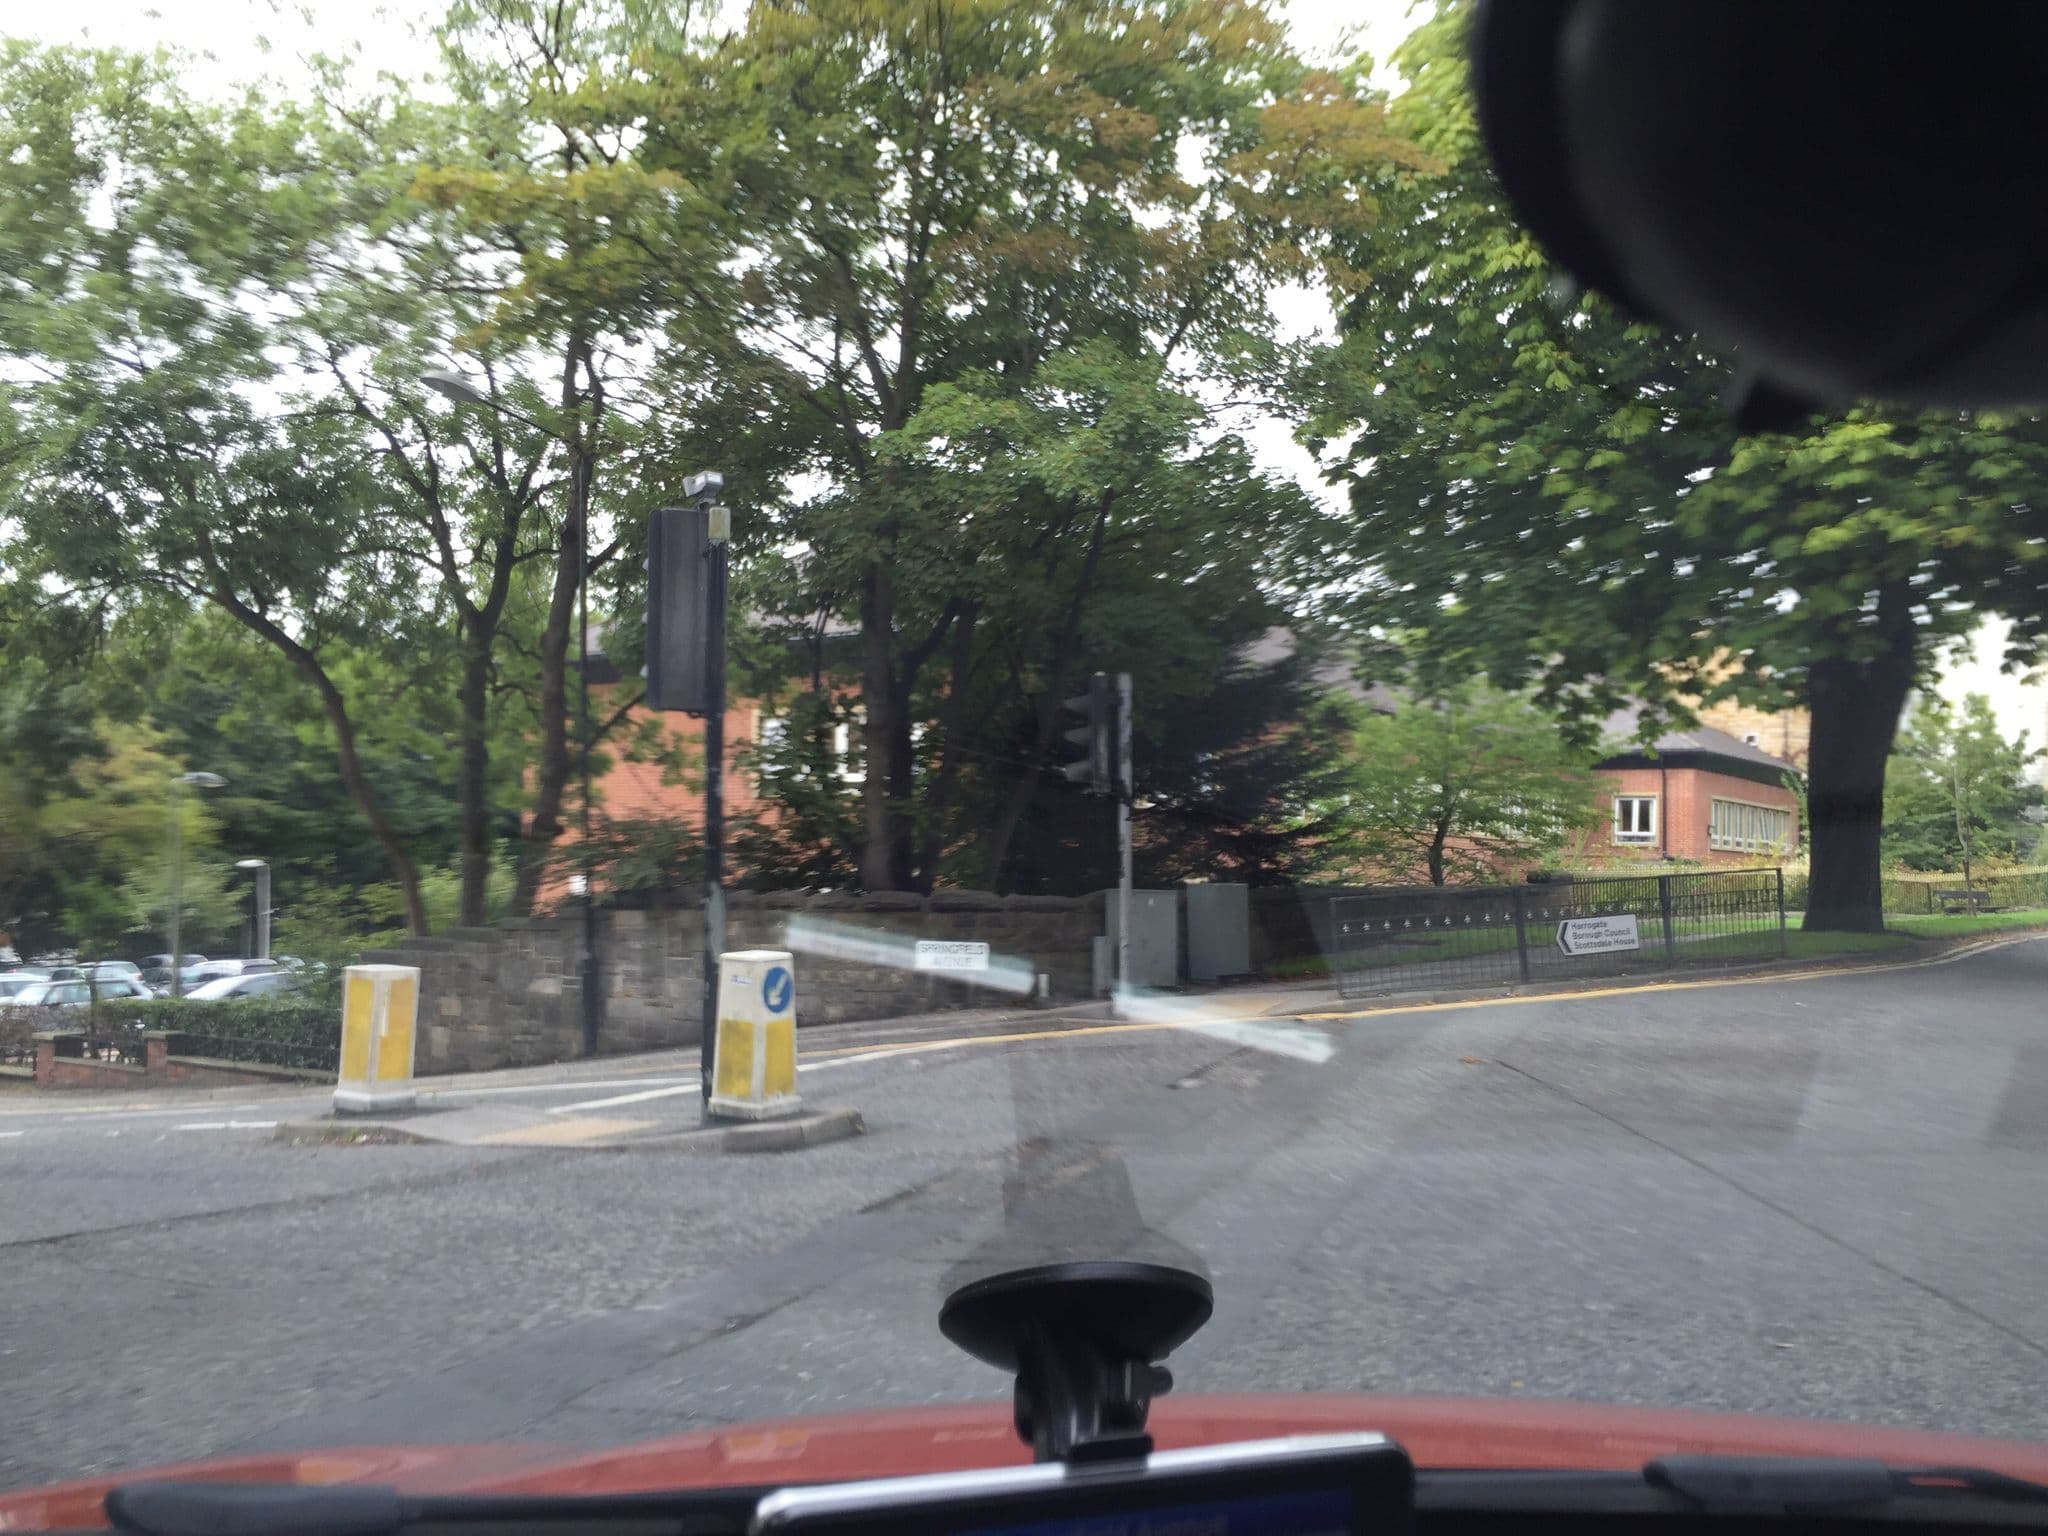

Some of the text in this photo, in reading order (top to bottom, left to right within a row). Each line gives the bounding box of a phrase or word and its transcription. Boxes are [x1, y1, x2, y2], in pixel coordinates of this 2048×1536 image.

[1571, 921, 1608, 930] Harrogate
[1572, 928, 1631, 940] Borough Council
[1613, 937, 1635, 945] House
